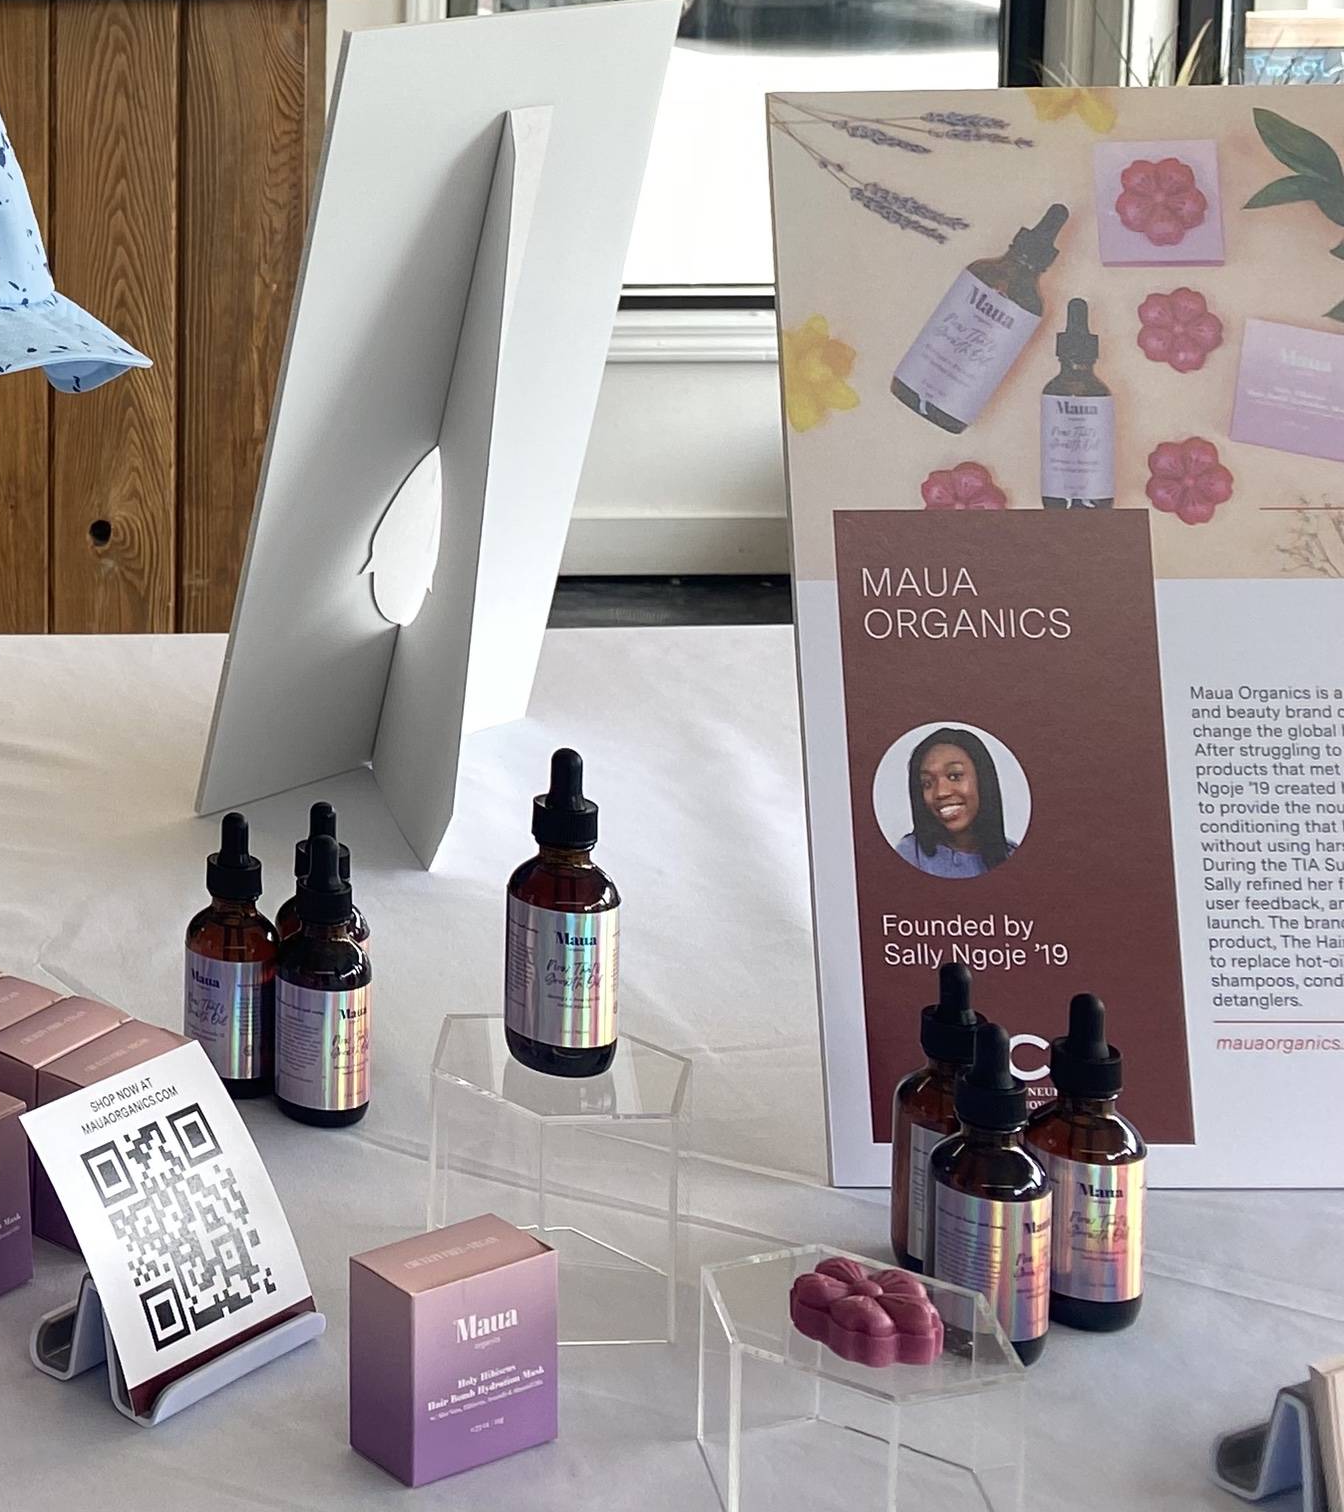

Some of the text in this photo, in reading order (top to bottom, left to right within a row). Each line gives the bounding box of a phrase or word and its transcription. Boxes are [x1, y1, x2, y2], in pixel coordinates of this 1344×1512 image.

[1056, 400, 1099, 416] Maua
[862, 567, 979, 597] MAUA
[864, 608, 1072, 639] ORGANICS
[1190, 685, 1343, 703] Maua Organics is a
[1191, 705, 1332, 721] and beauty brand
[1193, 724, 1337, 741] change the global
[1194, 743, 1342, 760] After struggling to
[1195, 762, 1342, 779] products that met
[1197, 781, 1244, 798] Ngoje
[1274, 781, 1336, 795] created
[1198, 801, 1311, 816] to provide the
[1199, 820, 1338, 836] conditioning that
[1201, 839, 1311, 855] without using
[1203, 857, 1320, 875] During the TIA
[1204, 877, 1334, 893] Sally refined her
[1205, 896, 1325, 912] user feedback,
[882, 914, 1034, 940] Founded by
[1207, 915, 1299, 929] launch. The
[556, 931, 597, 946] Maua
[1208, 934, 1311, 951] product, The
[884, 943, 943, 969] Sally
[952, 943, 1026, 970] Ngoje
[1209, 954, 1291, 970] to replace
[1211, 973, 1300, 990] shampoos,
[1212, 993, 1303, 1010] detanglers.
[90, 1077, 154, 1113] SHOP NOW AT
[80, 1085, 180, 1136] MAUAORGANICS.COM
[453, 1308, 519, 1344] Maua
[457, 1364, 517, 1389] Holy Hibiscus
[427, 1365, 545, 1412] Hair Bomb Hydration Mask
